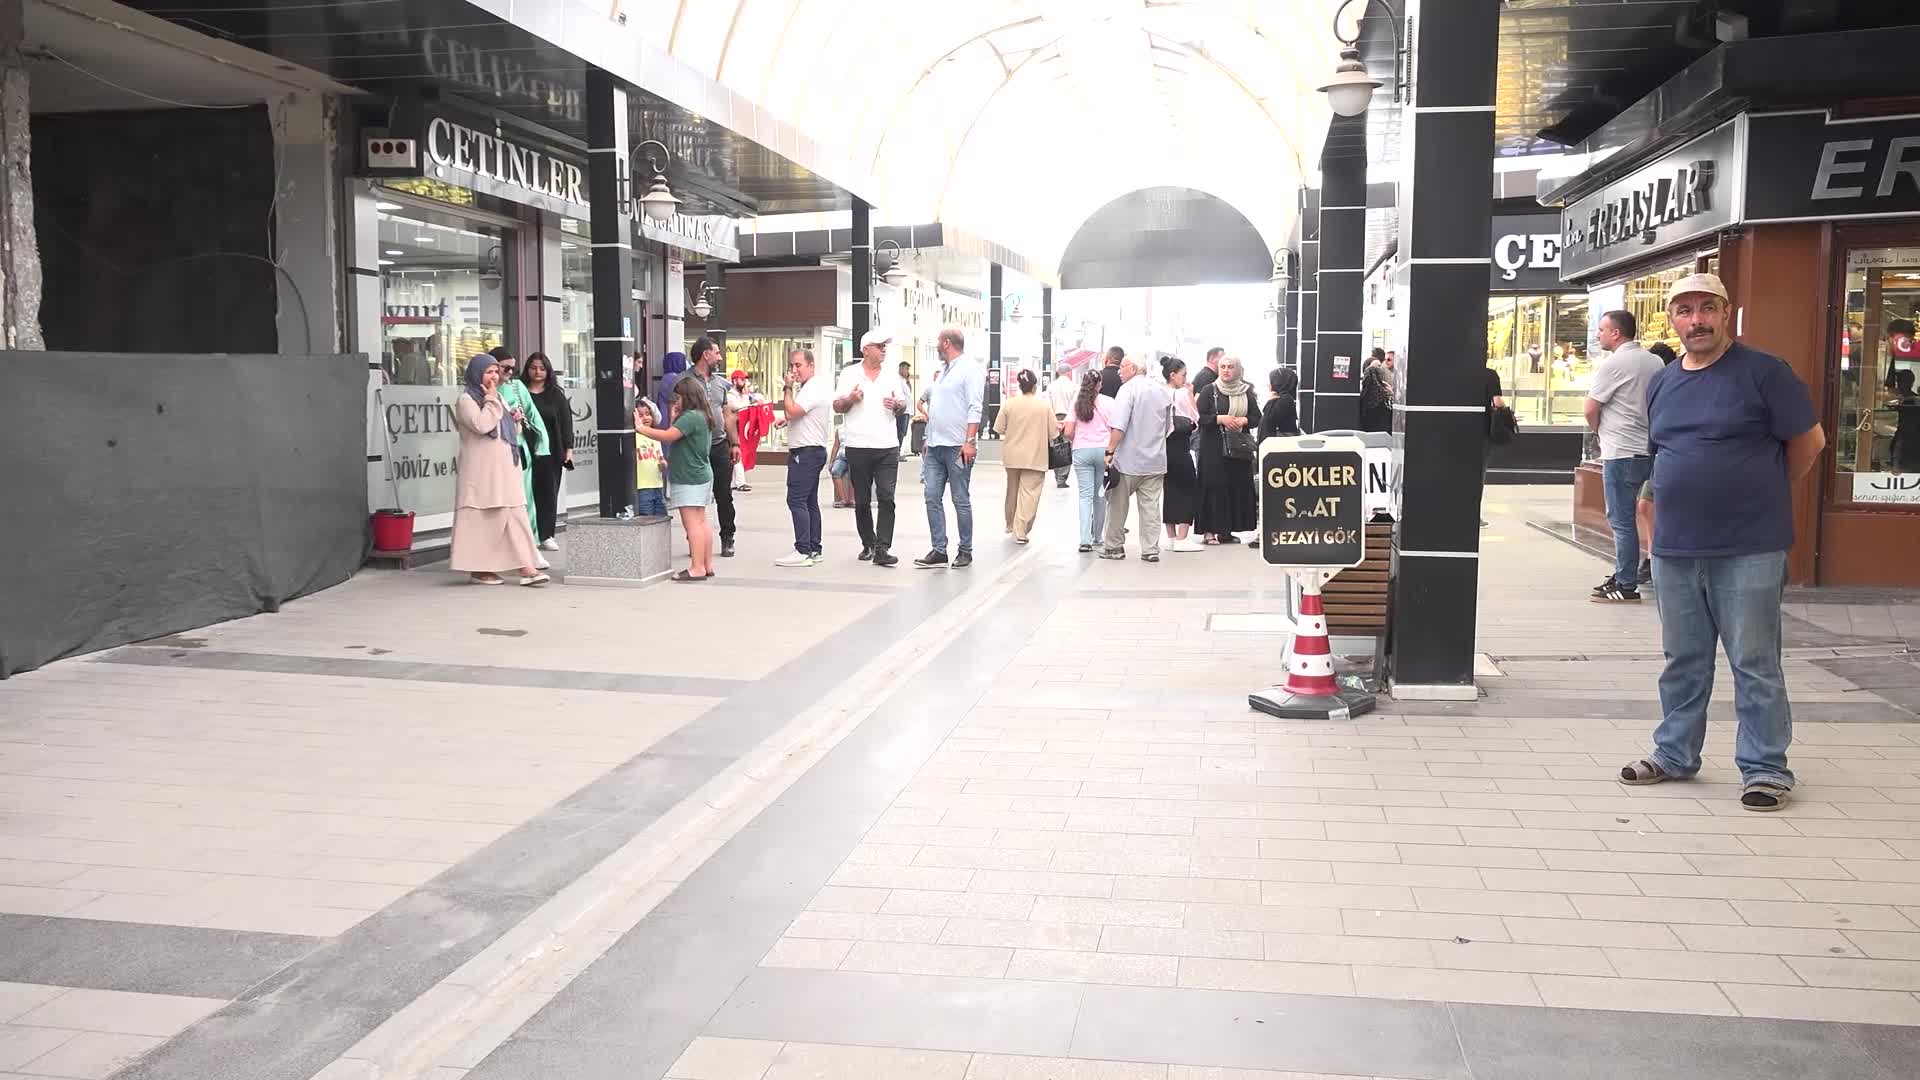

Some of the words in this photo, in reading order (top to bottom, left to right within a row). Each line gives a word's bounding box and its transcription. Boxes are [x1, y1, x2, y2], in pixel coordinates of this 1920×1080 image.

[428, 117, 585, 206] ÇETİNLER
[1811, 136, 1920, 200] ER
[1586, 160, 1714, 251] ERBAŞLAR
[1494, 234, 1561, 281] ÇE
[434, 461, 448, 476] ve
[1267, 463, 1357, 488] GÖKLER
[1365, 462, 1387, 494] N
[1284, 497, 1341, 519] SAT
[1271, 529, 1319, 546] SEZAYİ
[1323, 526, 1357, 545] GÖK
